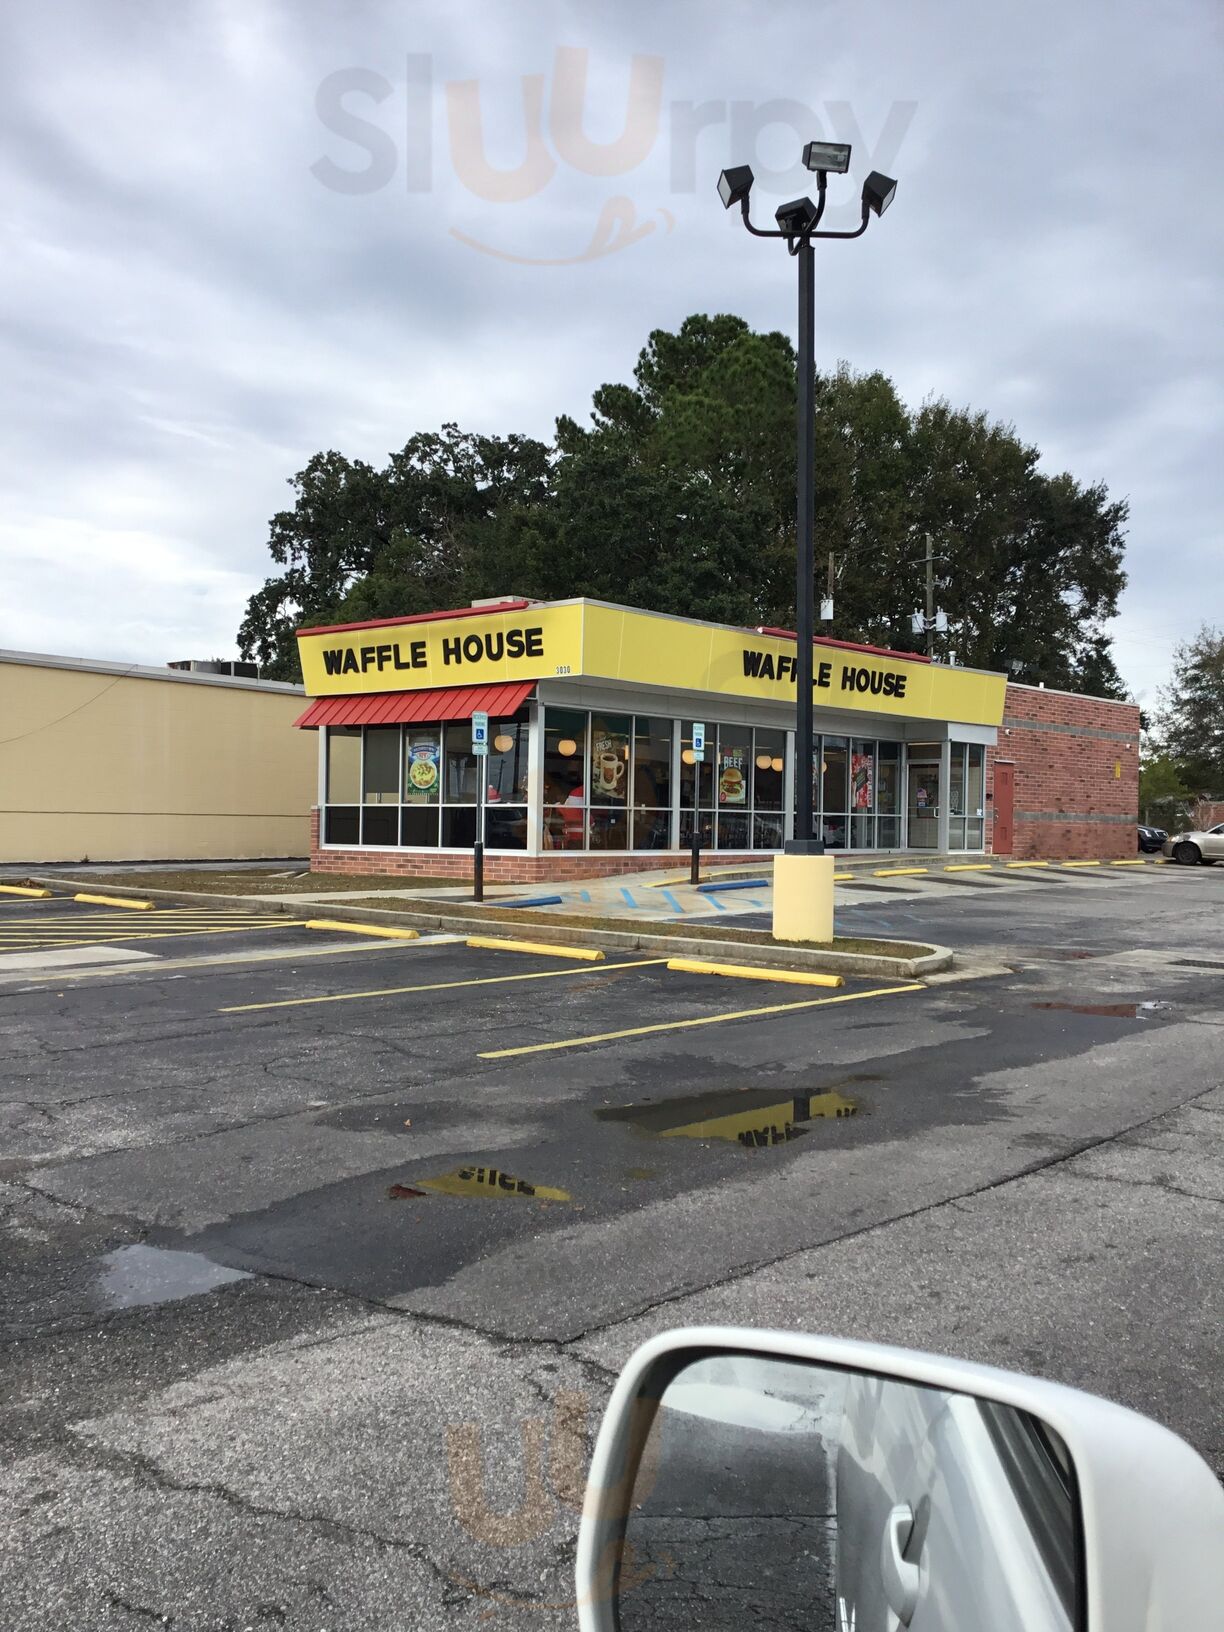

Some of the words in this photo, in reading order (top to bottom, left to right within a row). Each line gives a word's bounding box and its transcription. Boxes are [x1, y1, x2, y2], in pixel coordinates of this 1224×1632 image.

[323, 641, 428, 676] WAFFLE
[442, 627, 545, 666] HOUSE
[743, 650, 832, 688] WAFFE
[841, 666, 907, 698] HOUSE
[595, 739, 612, 752] FRESH
[723, 756, 743, 769] BEEF
